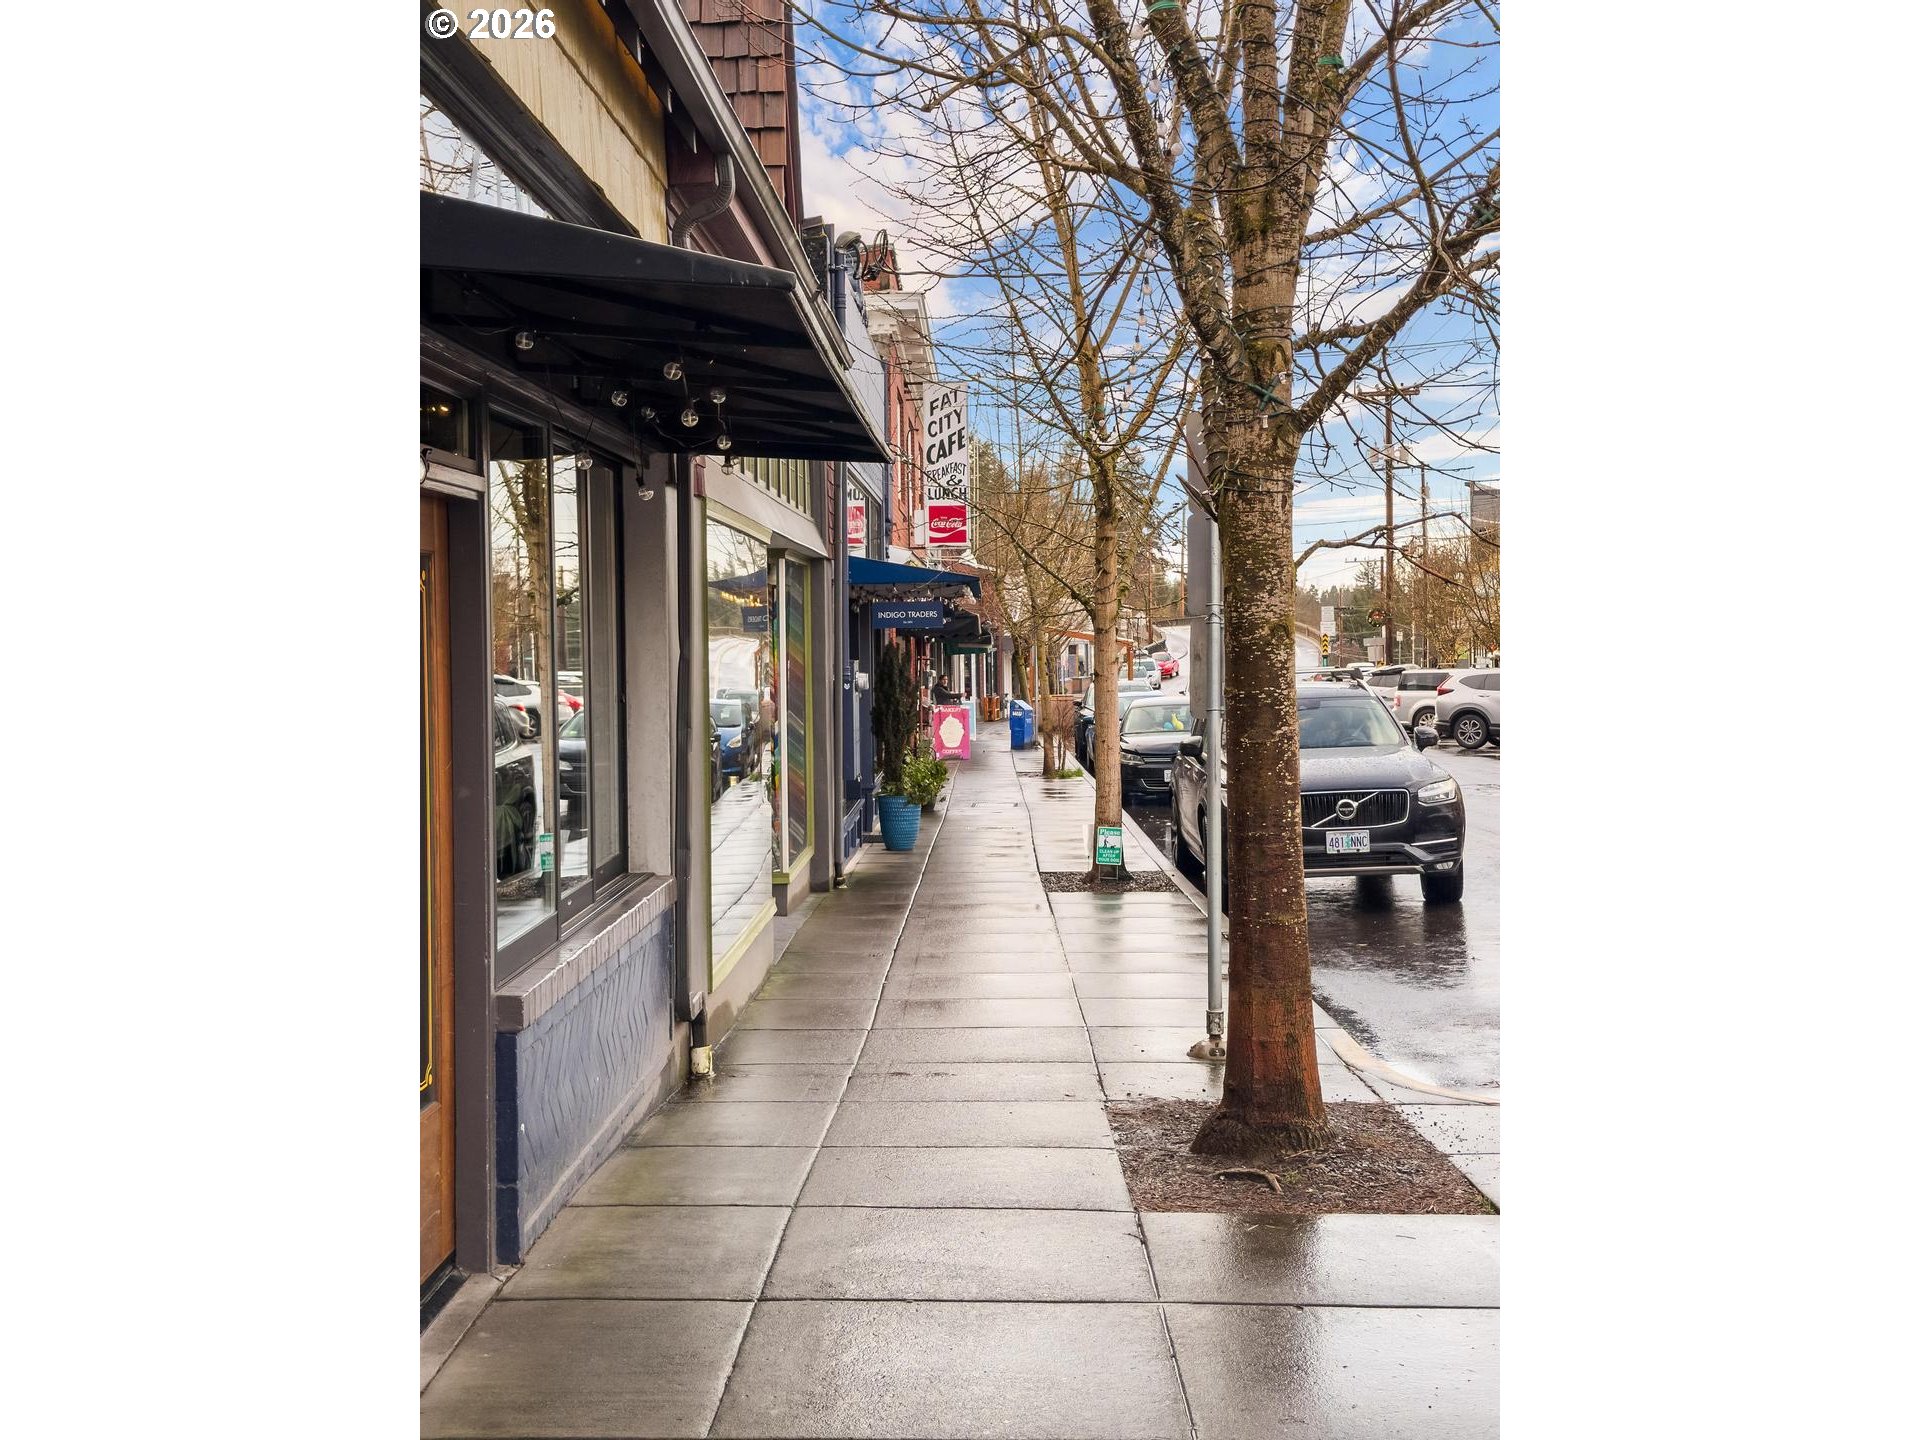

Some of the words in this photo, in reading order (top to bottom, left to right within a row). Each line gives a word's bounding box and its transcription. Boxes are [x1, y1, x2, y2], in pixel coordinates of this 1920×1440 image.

[930, 386, 960, 417] FAT
[928, 404, 964, 438] CITY
[926, 426, 966, 465] CAFE
[927, 462, 967, 482] BREAKFAST
[946, 475, 963, 487] &
[928, 488, 967, 500] LUNCH
[877, 611, 906, 619] INDIGO
[908, 610, 938, 618] TRADERS
[1329, 837, 1344, 848] 481
[1350, 836, 1368, 848] NNC
